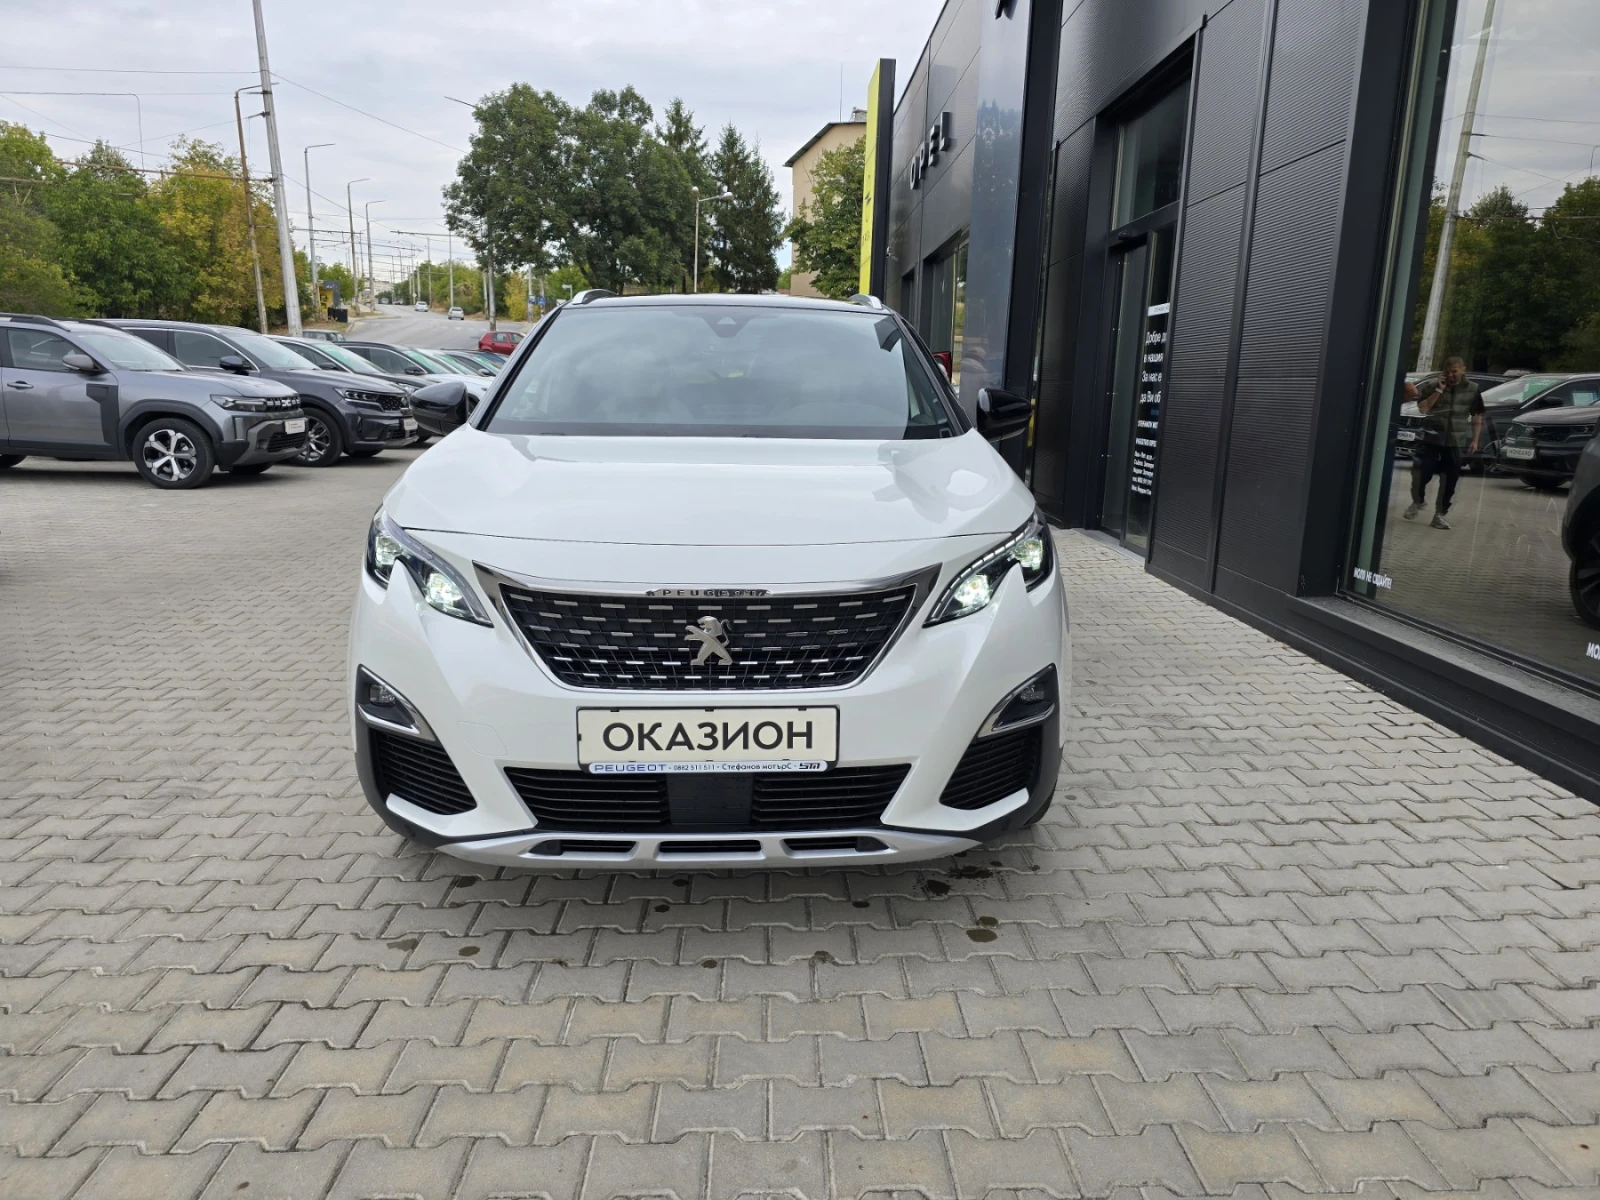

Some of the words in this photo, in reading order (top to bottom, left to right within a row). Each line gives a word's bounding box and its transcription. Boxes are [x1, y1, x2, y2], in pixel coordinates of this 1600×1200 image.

[910, 112, 951, 190] OPEL
[662, 589, 758, 597] PEUGEOT
[602, 720, 813, 751] ОКАЗИОН
[594, 763, 667, 772] PEUGEOT
[721, 763, 761, 771] Стефанов
